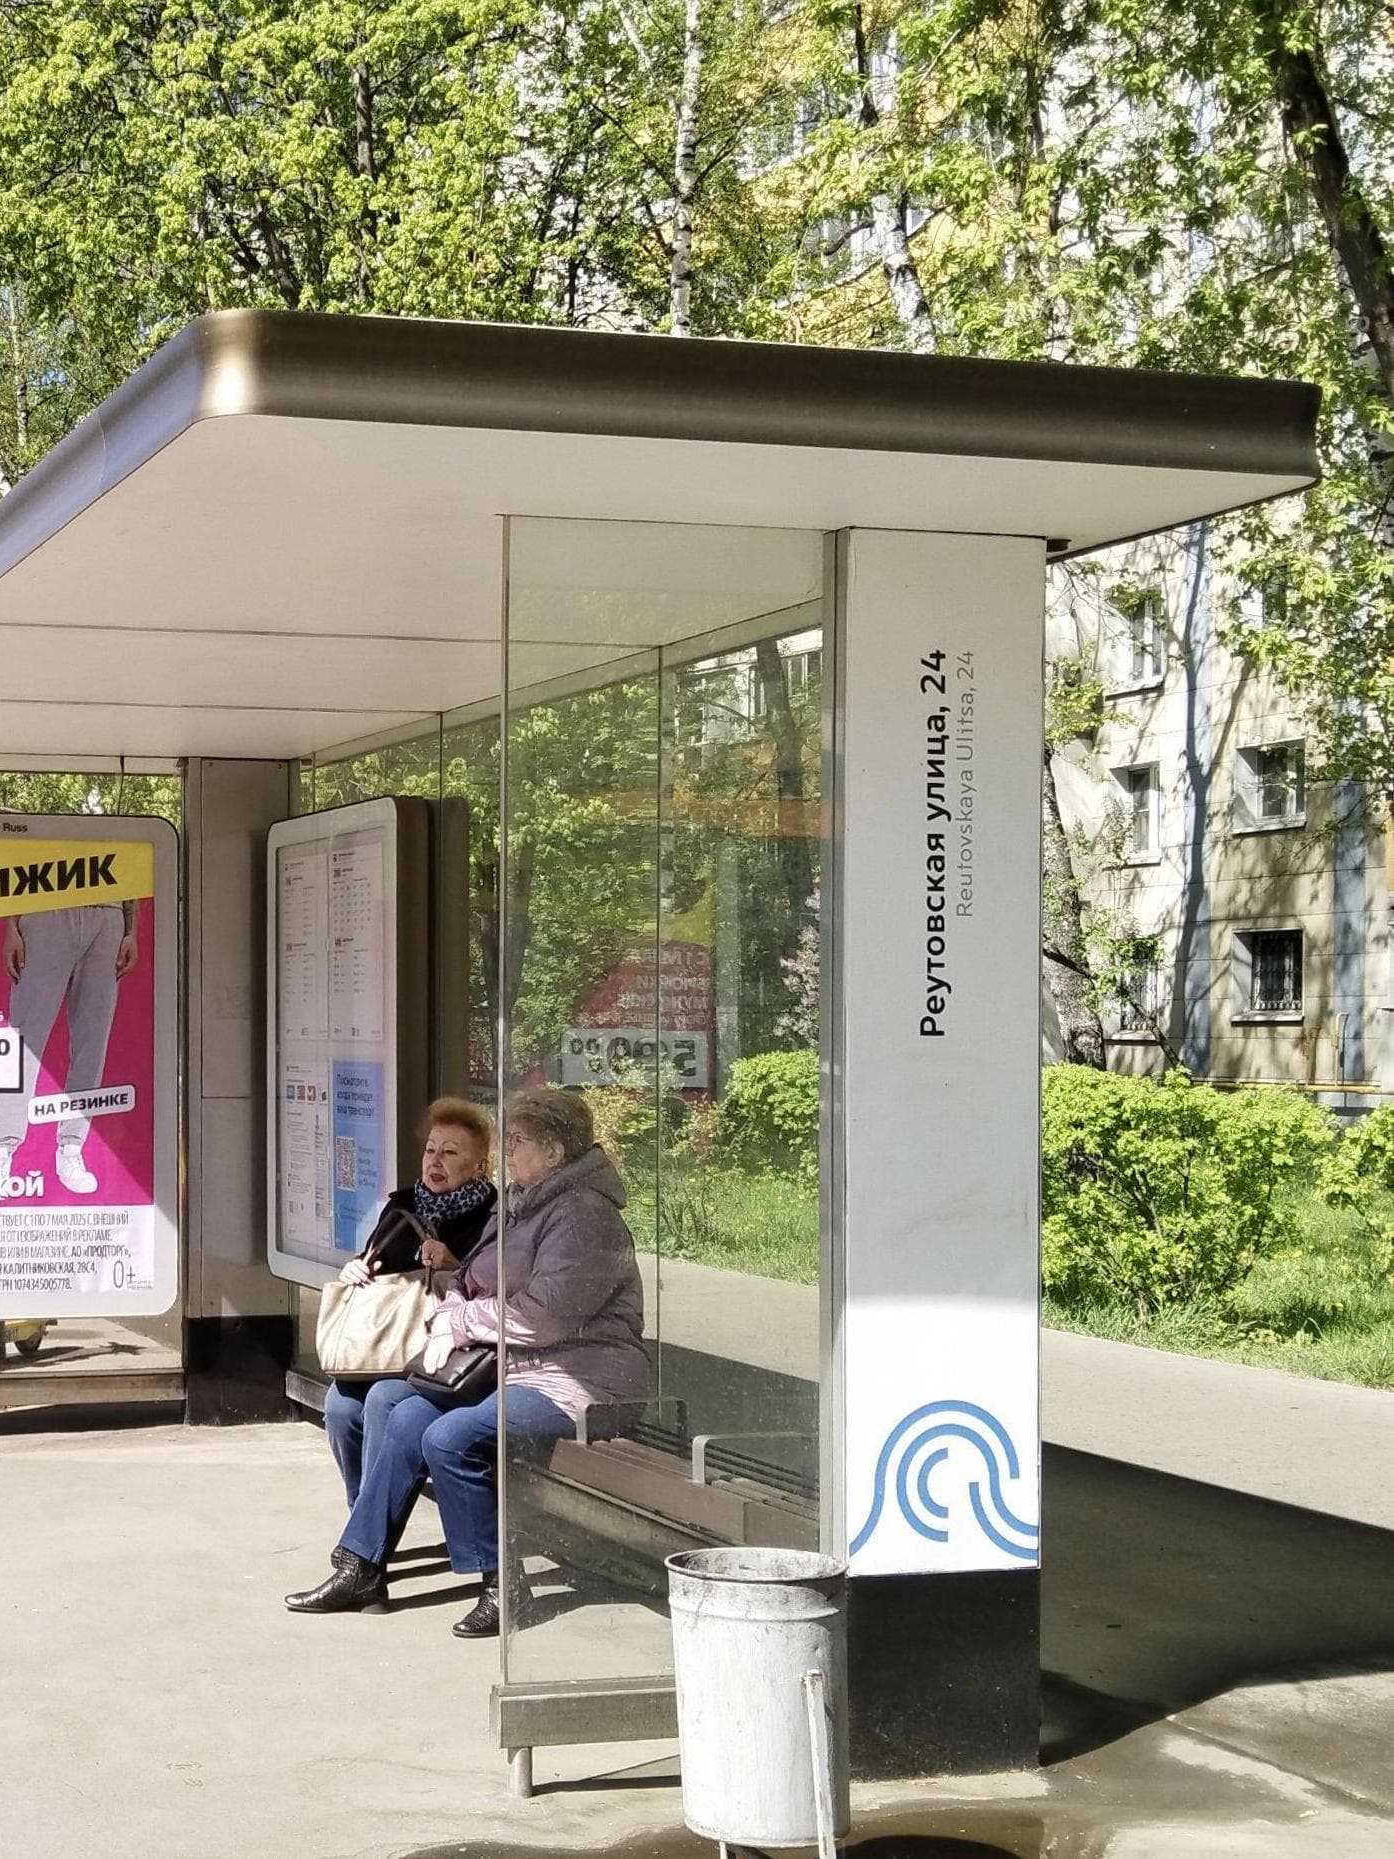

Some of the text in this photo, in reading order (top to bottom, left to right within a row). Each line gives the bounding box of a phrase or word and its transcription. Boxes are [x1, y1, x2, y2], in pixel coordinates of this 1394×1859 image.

[955, 650, 977, 917] Reutovskaya Ulitsa, 24
[2, 822, 28, 833] Russ
[920, 649, 952, 1037] Реутовская улица, 24
[34, 1093, 129, 1116] НА РЕЗИНКЕ
[113, 1260, 136, 1289] 0+
